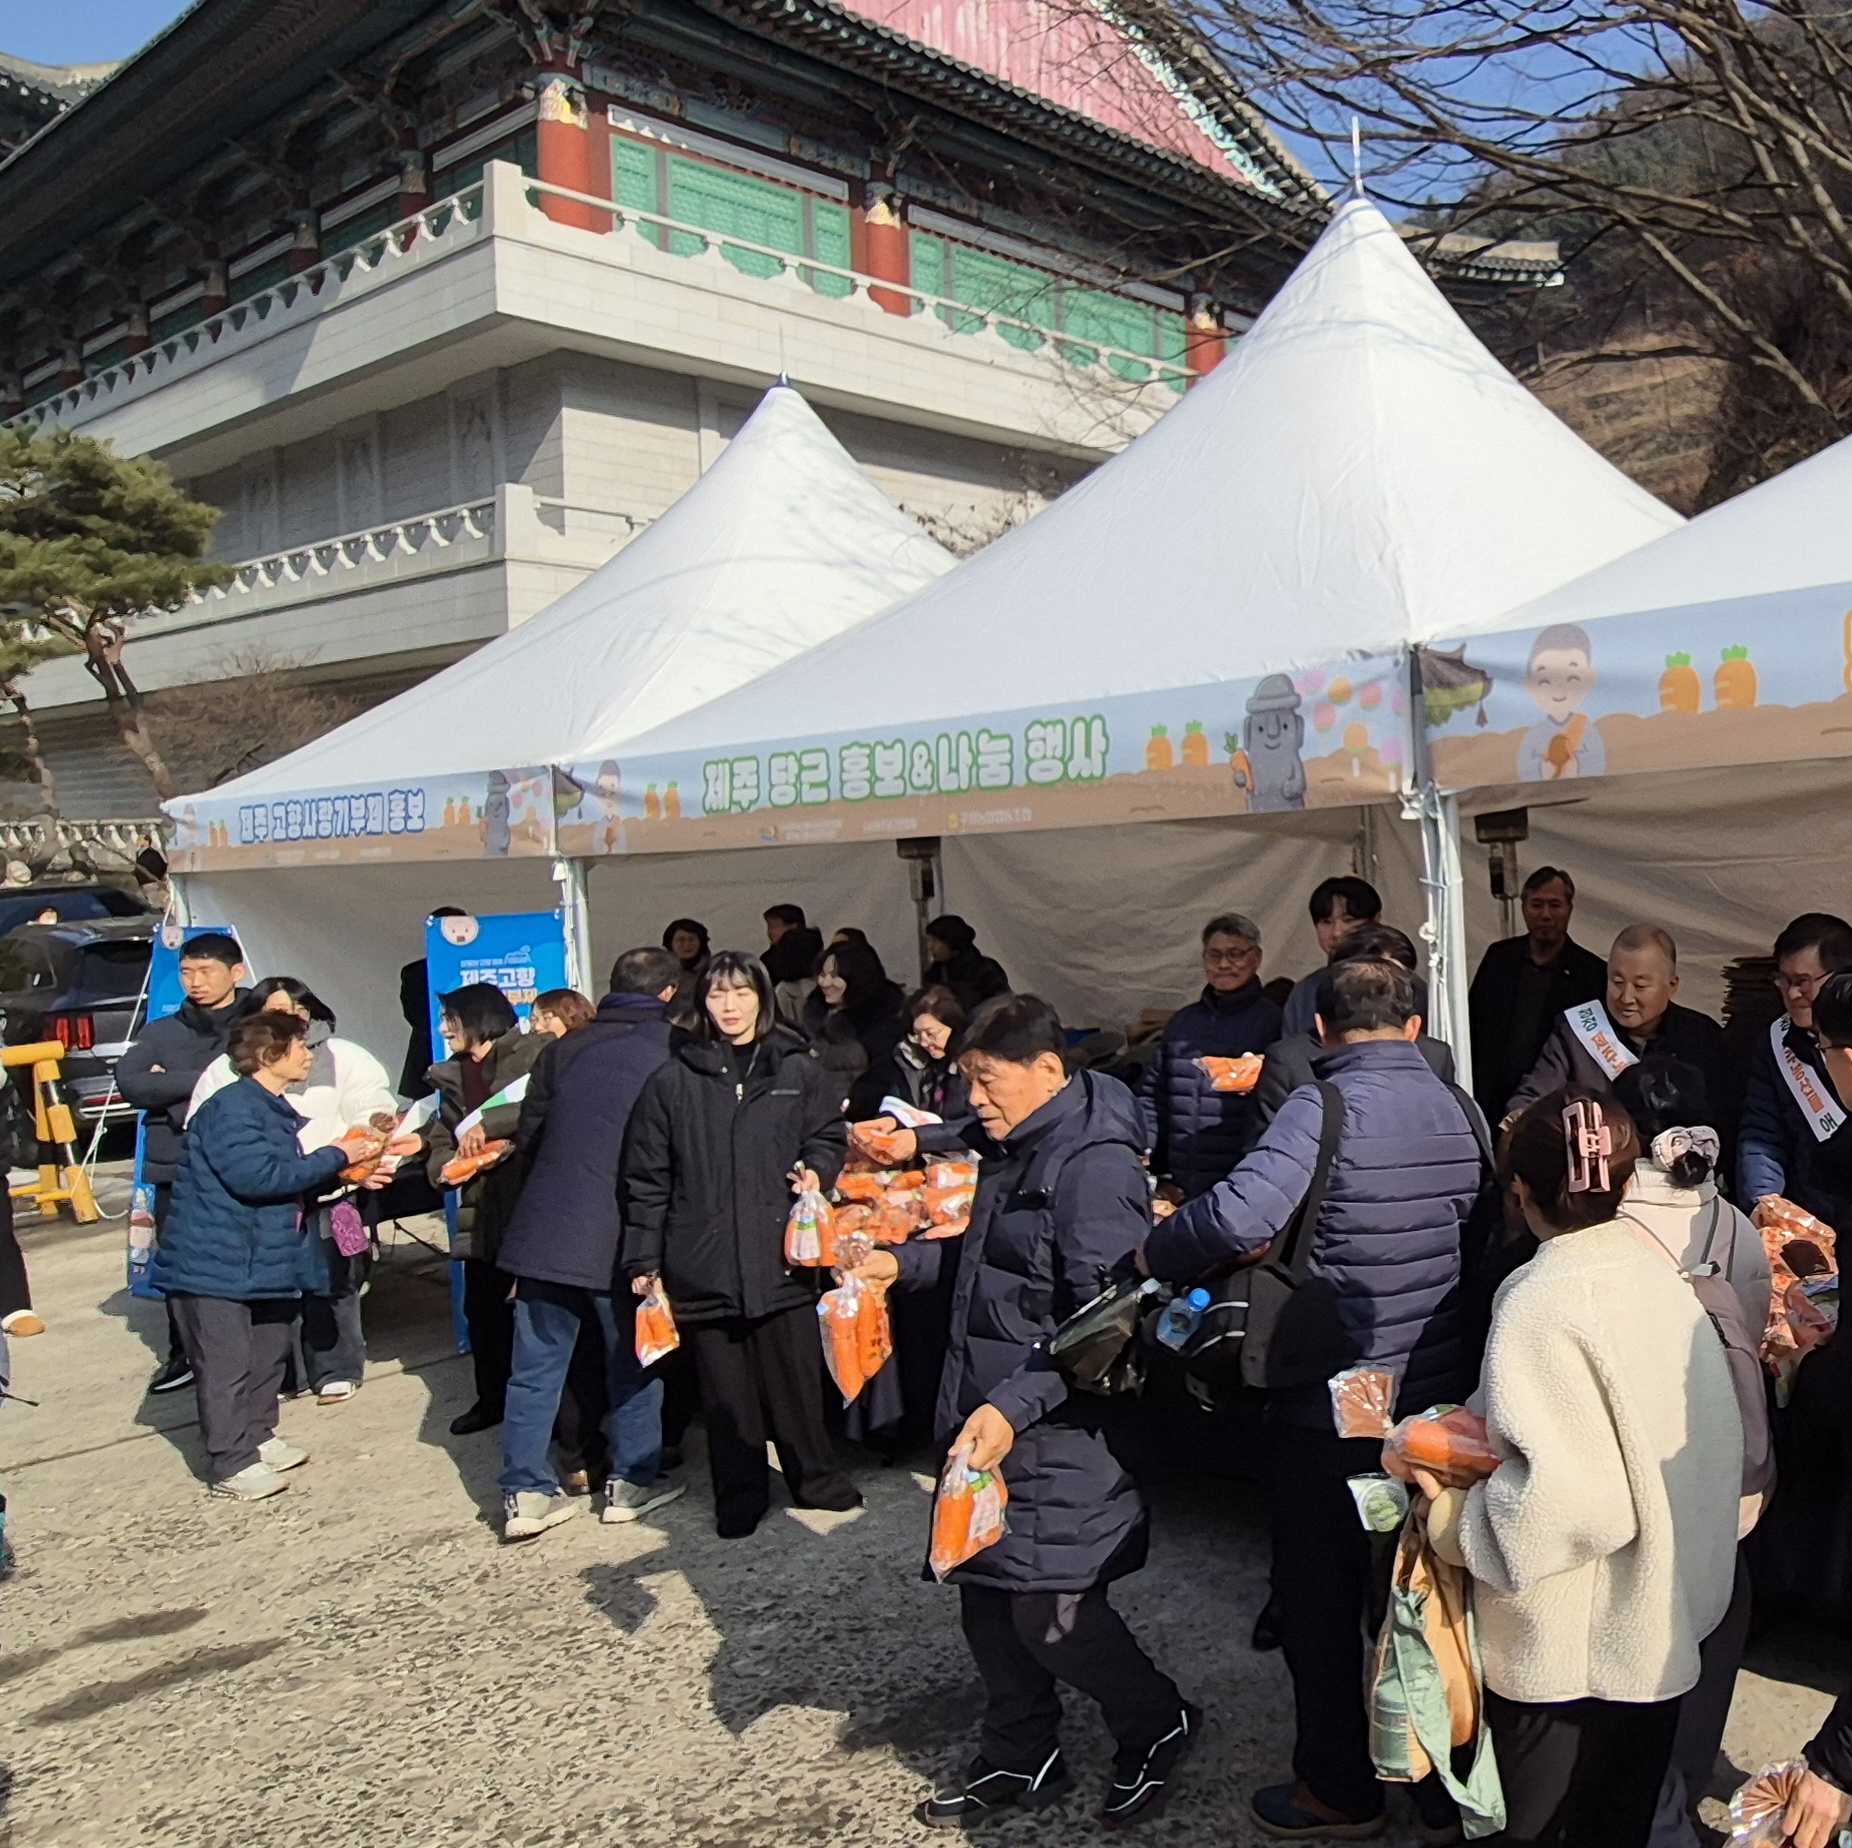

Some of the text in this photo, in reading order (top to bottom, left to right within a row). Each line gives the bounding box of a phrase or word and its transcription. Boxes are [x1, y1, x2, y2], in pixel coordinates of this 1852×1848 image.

[702, 714, 1109, 816] 제주 당근 홍보&나눔 행사
[239, 788, 425, 844] 제주 고향사랑기부제 홍보
[460, 966, 535, 988] 제주고향
